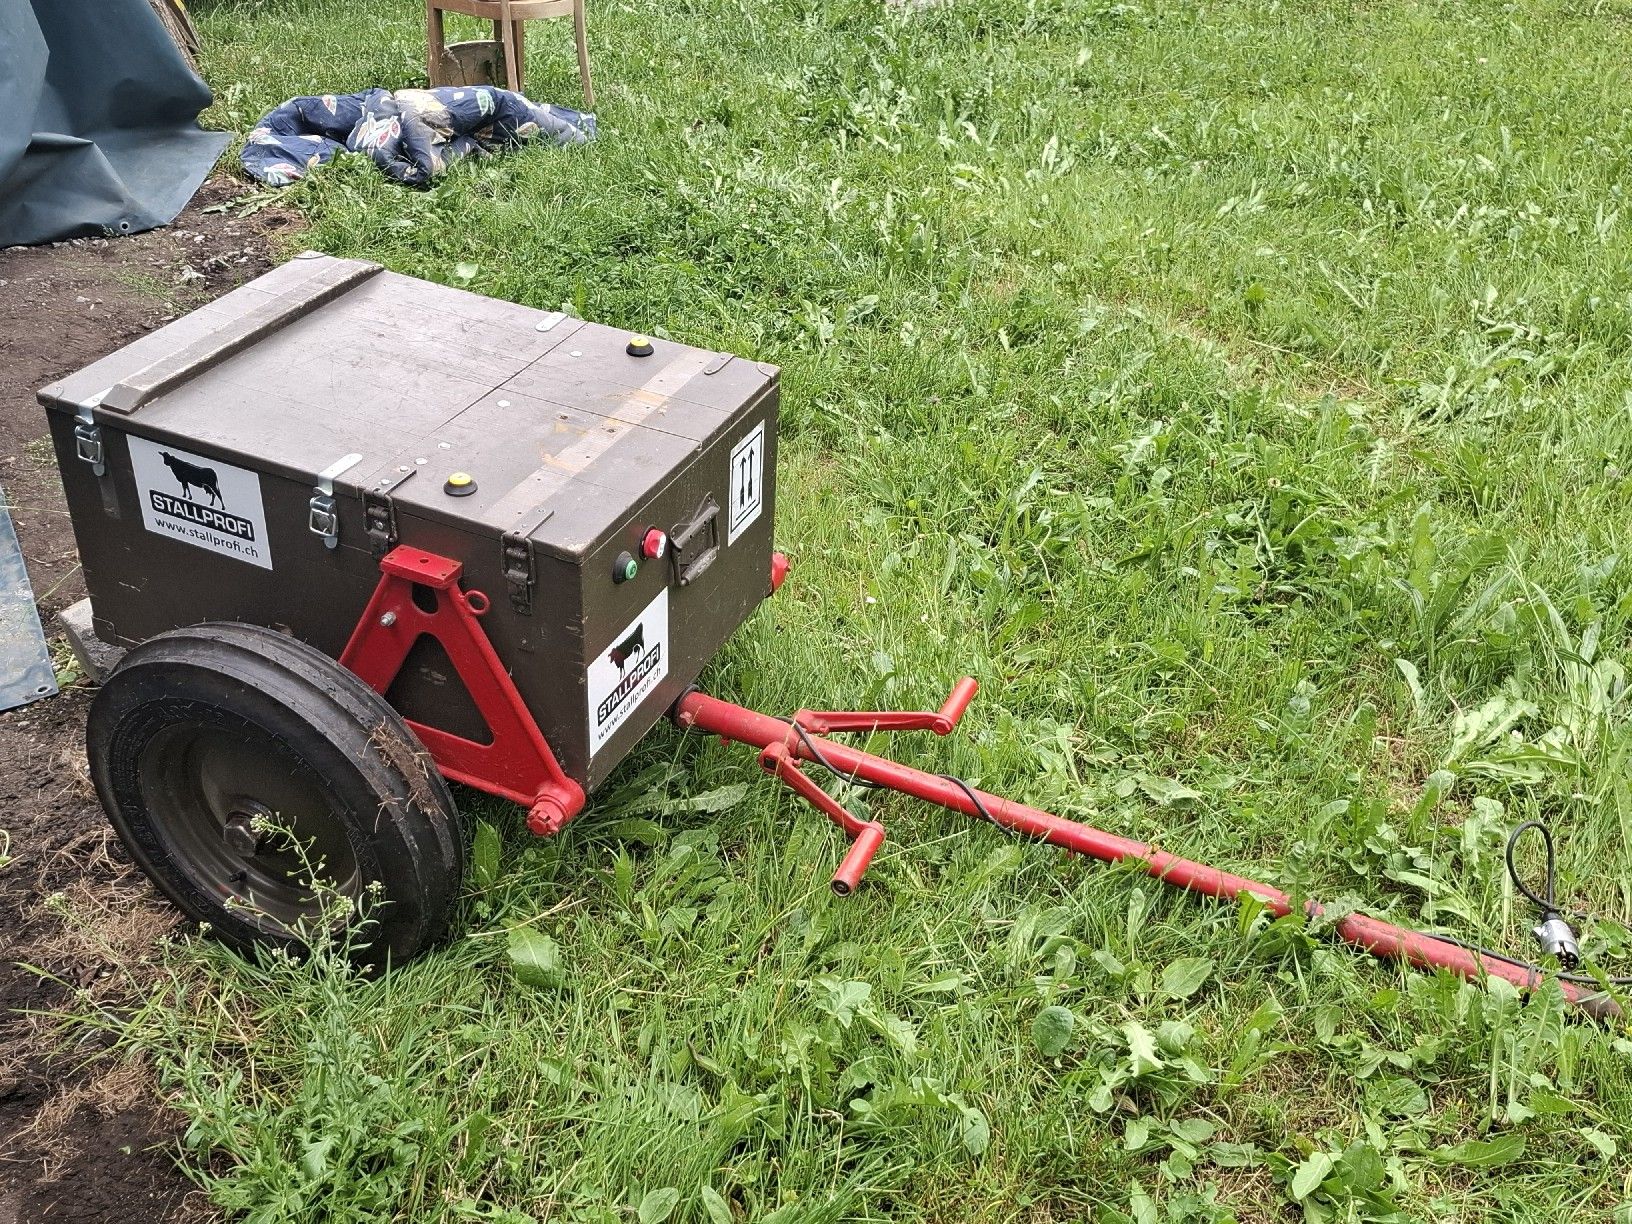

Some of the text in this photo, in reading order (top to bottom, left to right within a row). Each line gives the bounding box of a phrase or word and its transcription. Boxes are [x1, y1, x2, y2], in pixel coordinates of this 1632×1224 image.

[152, 493, 252, 538] STALLPROFI
[155, 517, 259, 558] www.stallprofi.ch
[598, 667, 661, 740] www.stallprofi.ch
[599, 647, 659, 720] STALLPROFI
